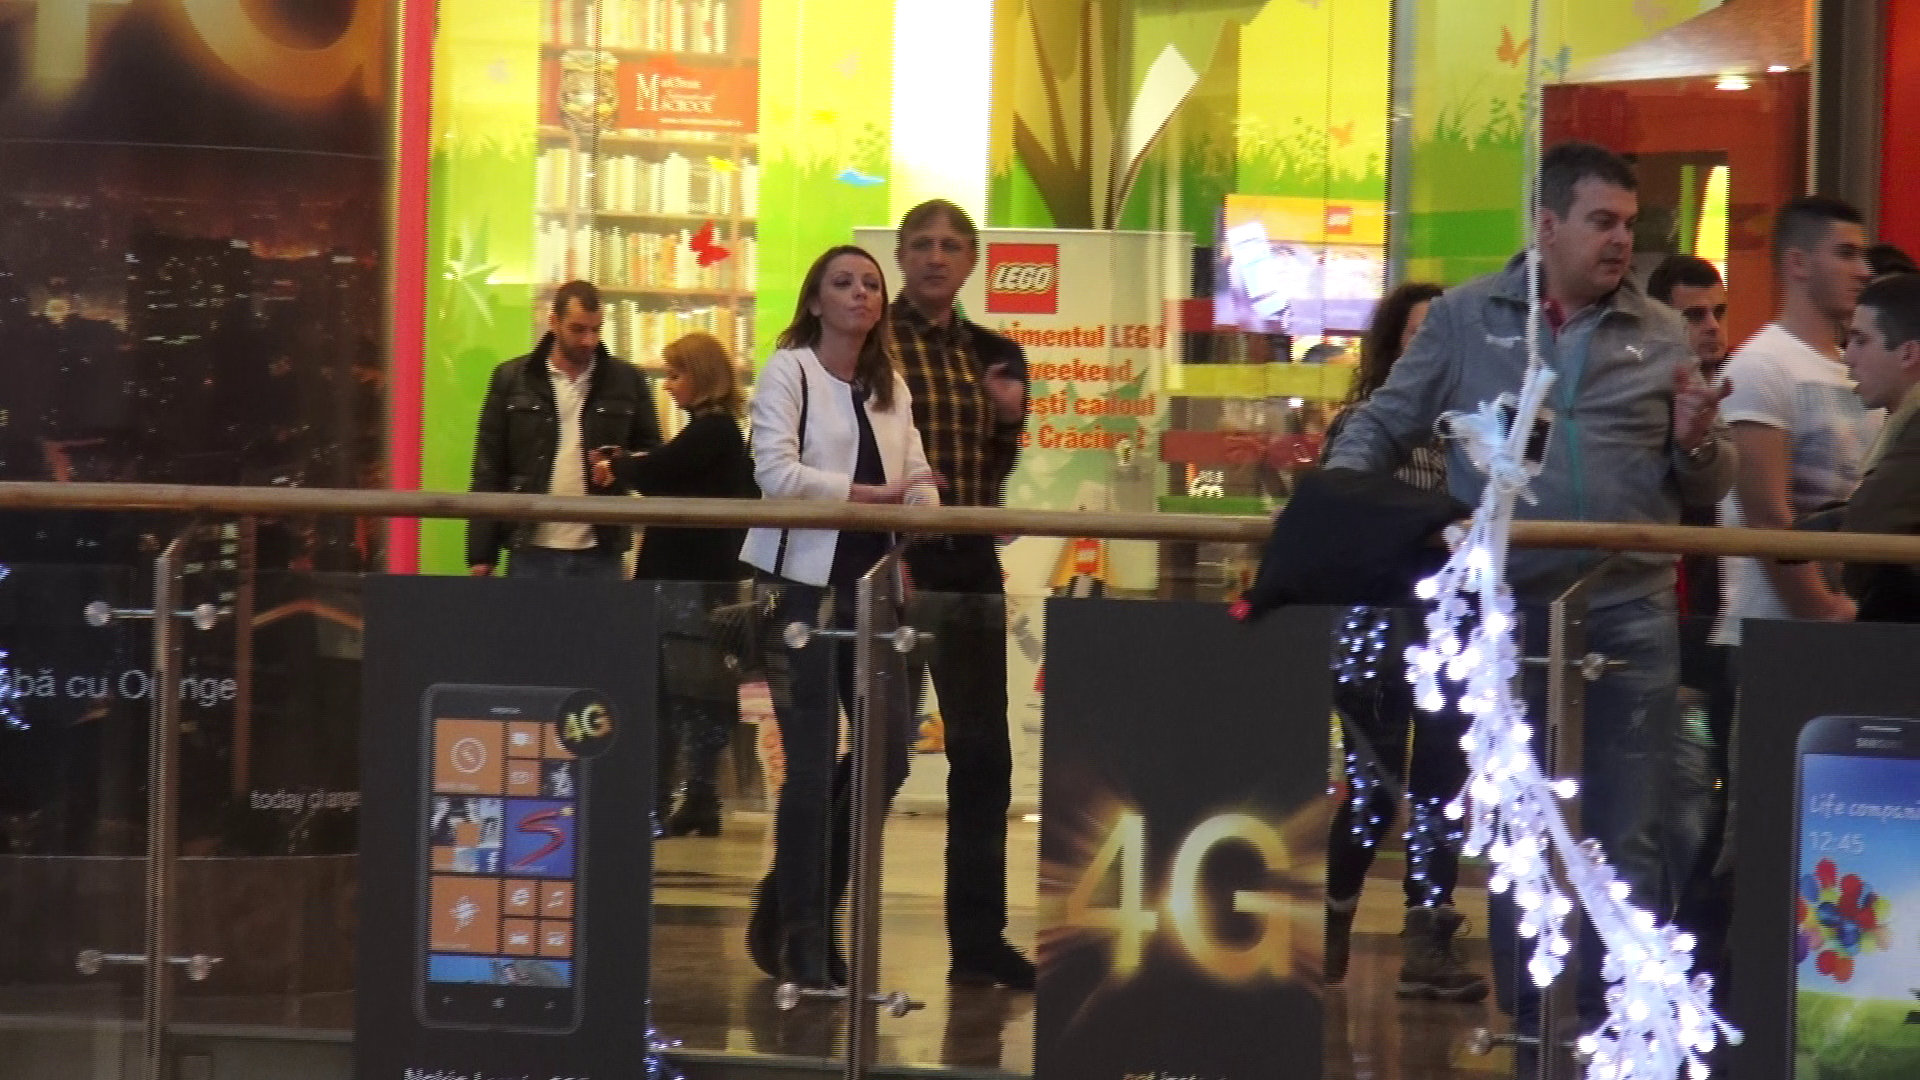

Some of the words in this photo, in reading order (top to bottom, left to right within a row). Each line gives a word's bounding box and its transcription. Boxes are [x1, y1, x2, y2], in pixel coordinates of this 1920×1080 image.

[992, 264, 1054, 291] LEGO
[1111, 324, 1166, 349] LEGO
[1073, 392, 1156, 416] cadoul
[65, 675, 108, 699] cu
[118, 669, 238, 707] Ornge
[563, 703, 613, 744] 4G
[250, 788, 305, 815] today
[1809, 793, 1846, 819] Life
[1809, 831, 1865, 855] 12:45
[1066, 810, 1292, 979] 4G
